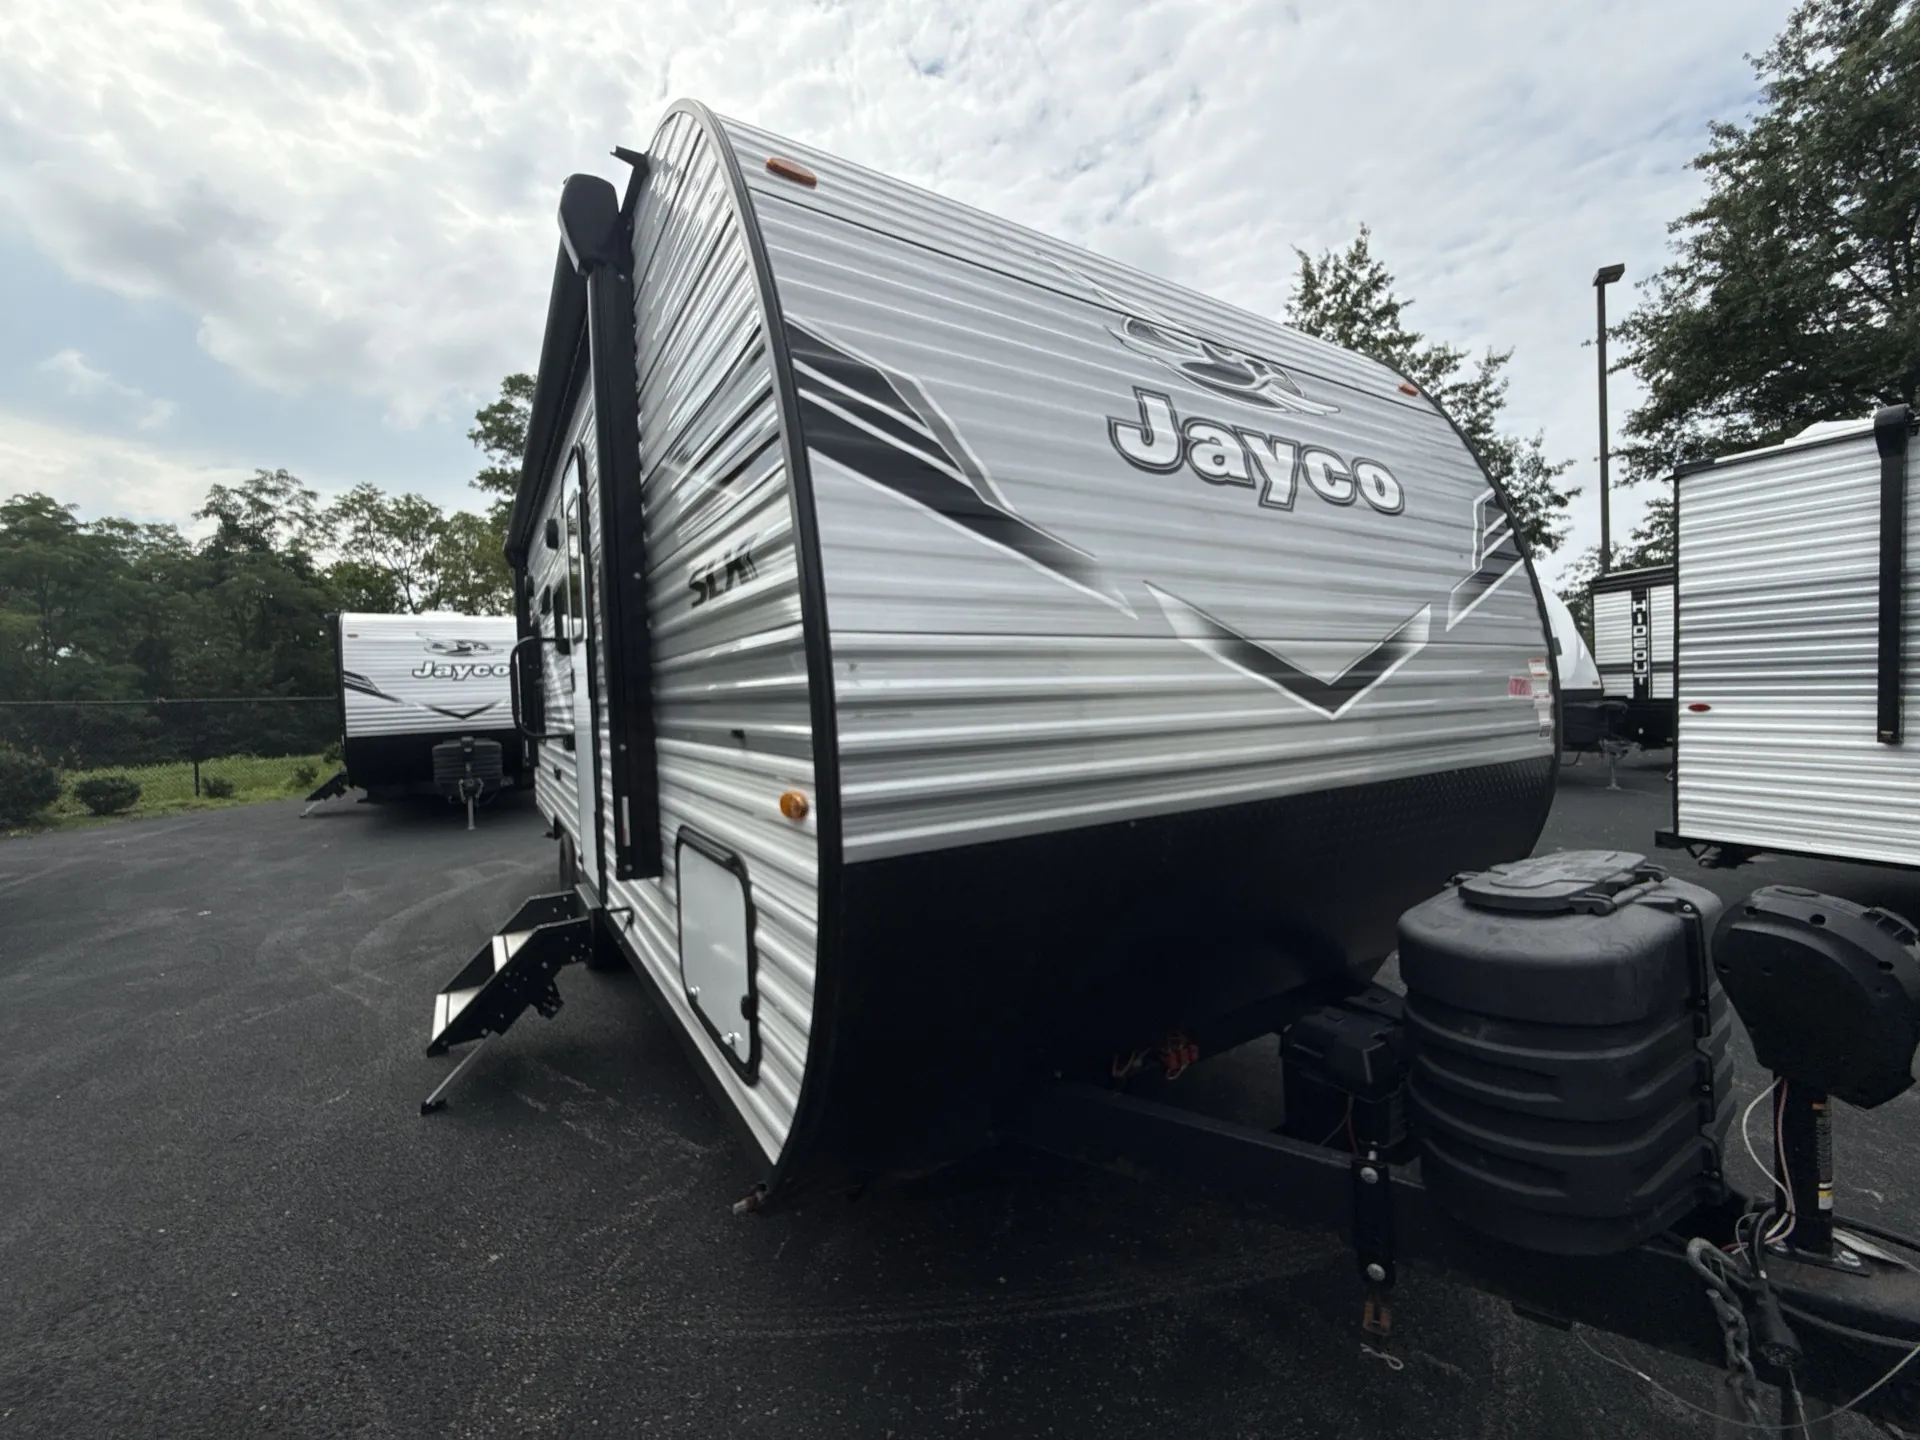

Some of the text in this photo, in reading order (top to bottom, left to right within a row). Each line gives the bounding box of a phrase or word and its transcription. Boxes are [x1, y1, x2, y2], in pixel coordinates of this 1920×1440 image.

[1106, 386, 1405, 516] Jayco
[412, 660, 511, 681] Jayco
[1632, 599, 1648, 686] HIDEOUT
